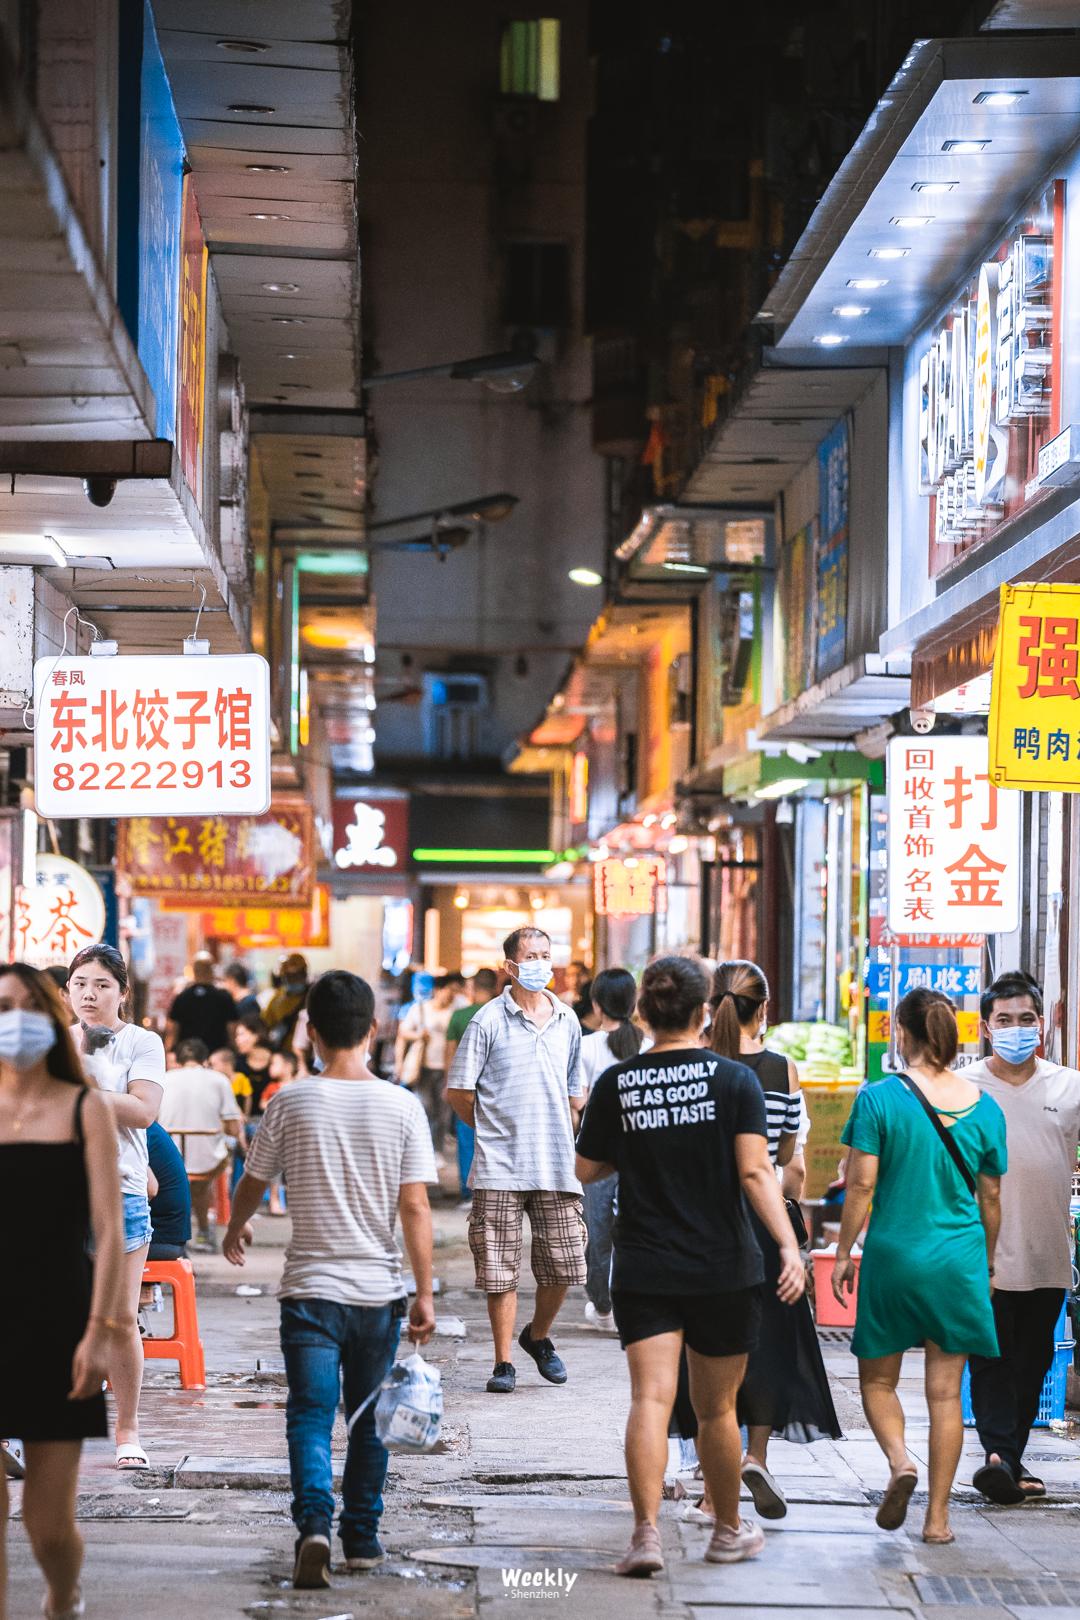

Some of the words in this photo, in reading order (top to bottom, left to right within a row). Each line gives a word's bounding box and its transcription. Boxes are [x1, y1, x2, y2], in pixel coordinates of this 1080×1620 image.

[1017, 616, 1080, 699] 强
[52, 670, 86, 686] 春凤
[50, 687, 252, 753] 东北饺子馆
[1014, 727, 1080, 761] 鸭肉
[52, 760, 252, 791] 82222913
[904, 748, 934, 921] 回收首饰名表
[944, 765, 1007, 907] 打金
[643, 1088, 664, 1105] AS
[666, 1081, 708, 1103] GOOD
[627, 1108, 669, 1131] YOUR
[670, 1100, 716, 1125] TASTE
